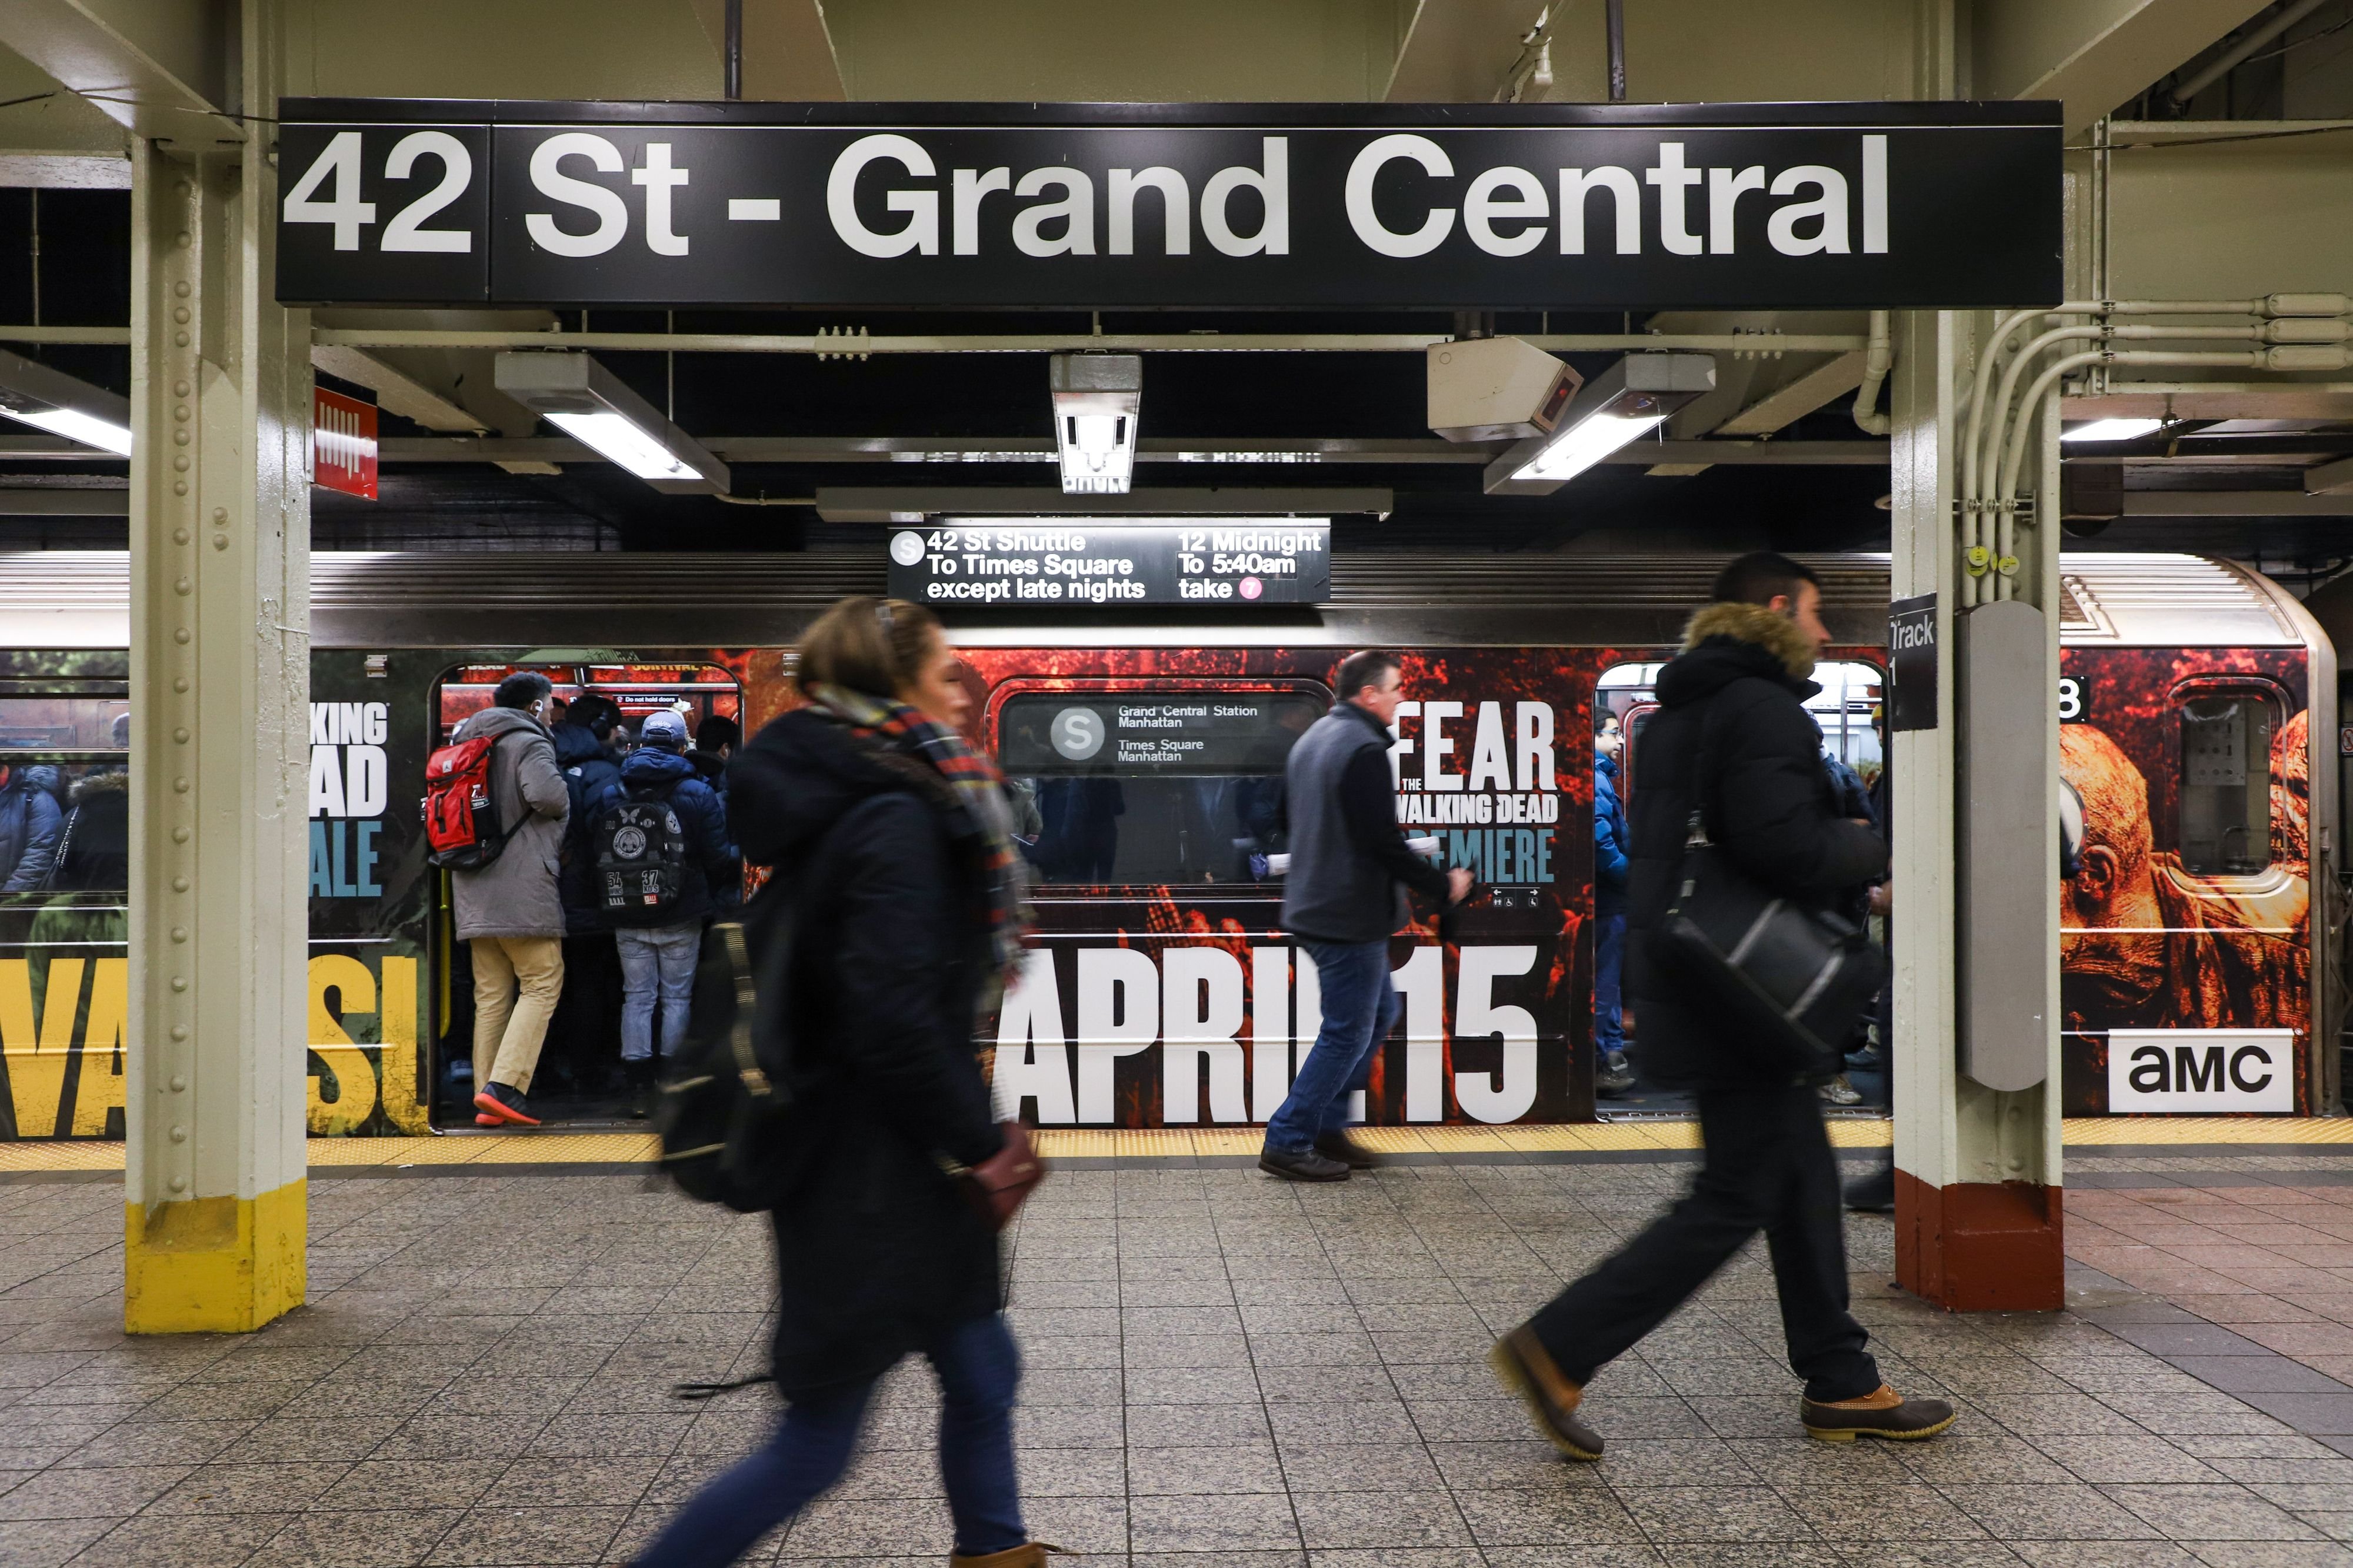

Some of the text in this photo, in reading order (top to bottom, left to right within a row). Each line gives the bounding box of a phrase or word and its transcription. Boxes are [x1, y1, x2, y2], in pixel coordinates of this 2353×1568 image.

[284, 131, 1887, 258] 42 St - Grand Central
[926, 530, 1086, 551] 42 St Shuttle
[1178, 531, 1321, 556] 12 Midnight
[926, 553, 1134, 579] To Times Square
[1178, 553, 1295, 574] To 5:40am
[927, 578, 1145, 603] except late nights
[1178, 578, 1256, 598] take 7
[1890, 615, 1934, 650] Track
[1889, 657, 1896, 686] 1
[1118, 705, 1258, 717] Grand Central Station
[1118, 717, 1182, 728] Manhattan
[1064, 715, 1092, 750] S
[1118, 739, 1204, 752] Times Square
[1118, 751, 1182, 762] Manhattan
[1386, 701, 1558, 791] FEAR
[1402, 778, 1422, 791] THE
[1497, 794, 1558, 823] DEAD
[607, 872, 622, 888] 54
[642, 870, 658, 886] 37
[1389, 945, 1538, 1124] 15
